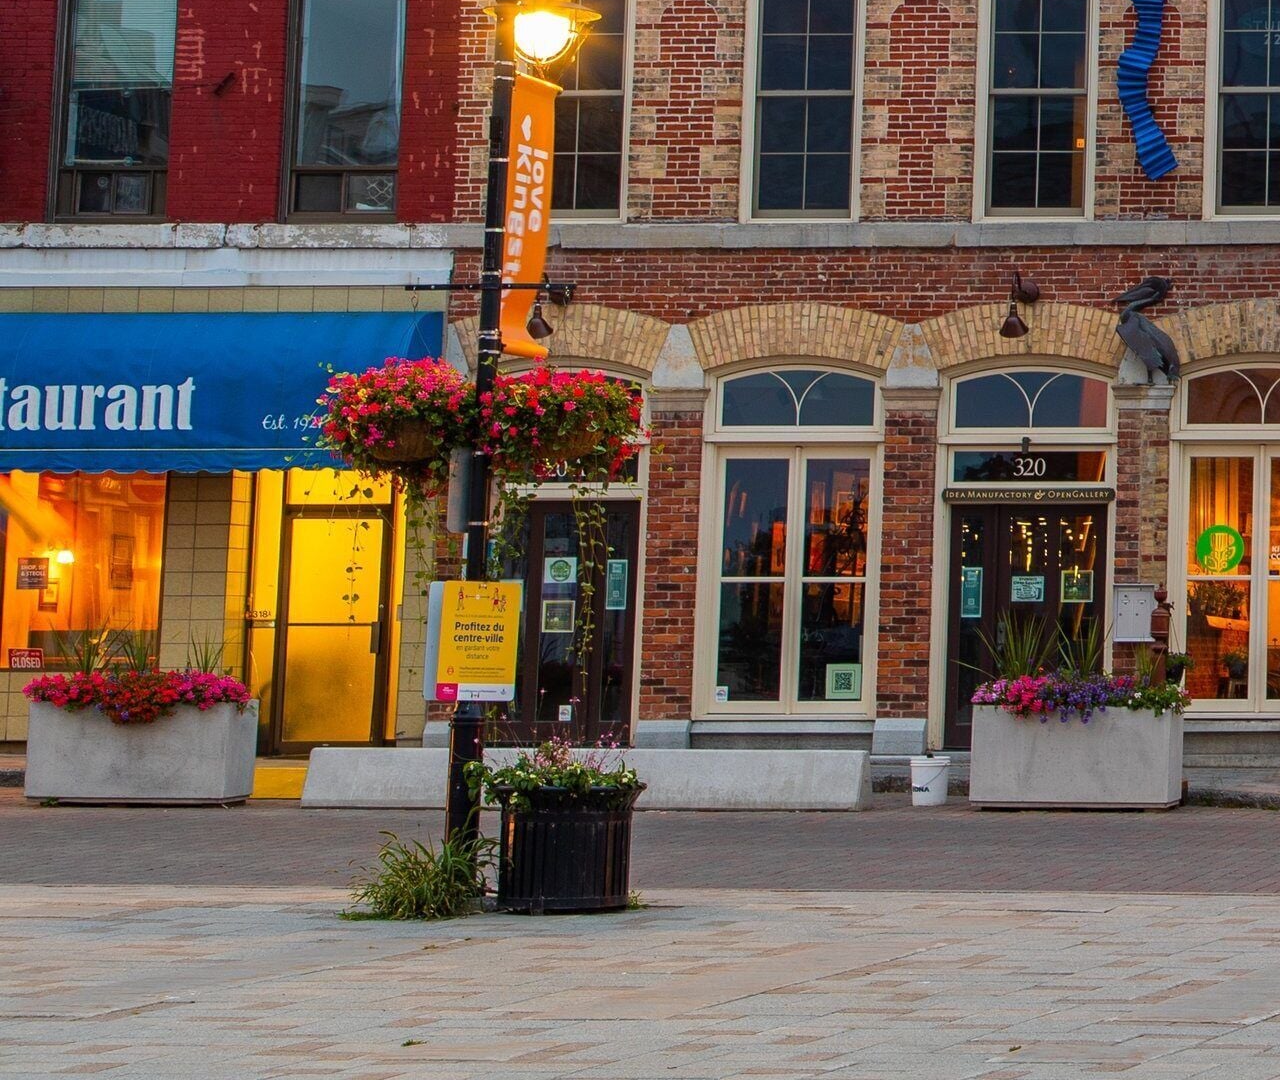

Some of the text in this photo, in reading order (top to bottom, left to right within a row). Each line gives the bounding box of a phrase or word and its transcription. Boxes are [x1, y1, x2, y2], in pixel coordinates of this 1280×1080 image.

[528, 148, 549, 233] love
[262, 414, 288, 430] Est.
[1013, 457, 1046, 476] 320
[454, 621, 505, 632] Profitez du
[453, 633, 504, 643] centre-ville
[464, 644, 485, 653] gardant
[11, 656, 41, 668] CLOSED
